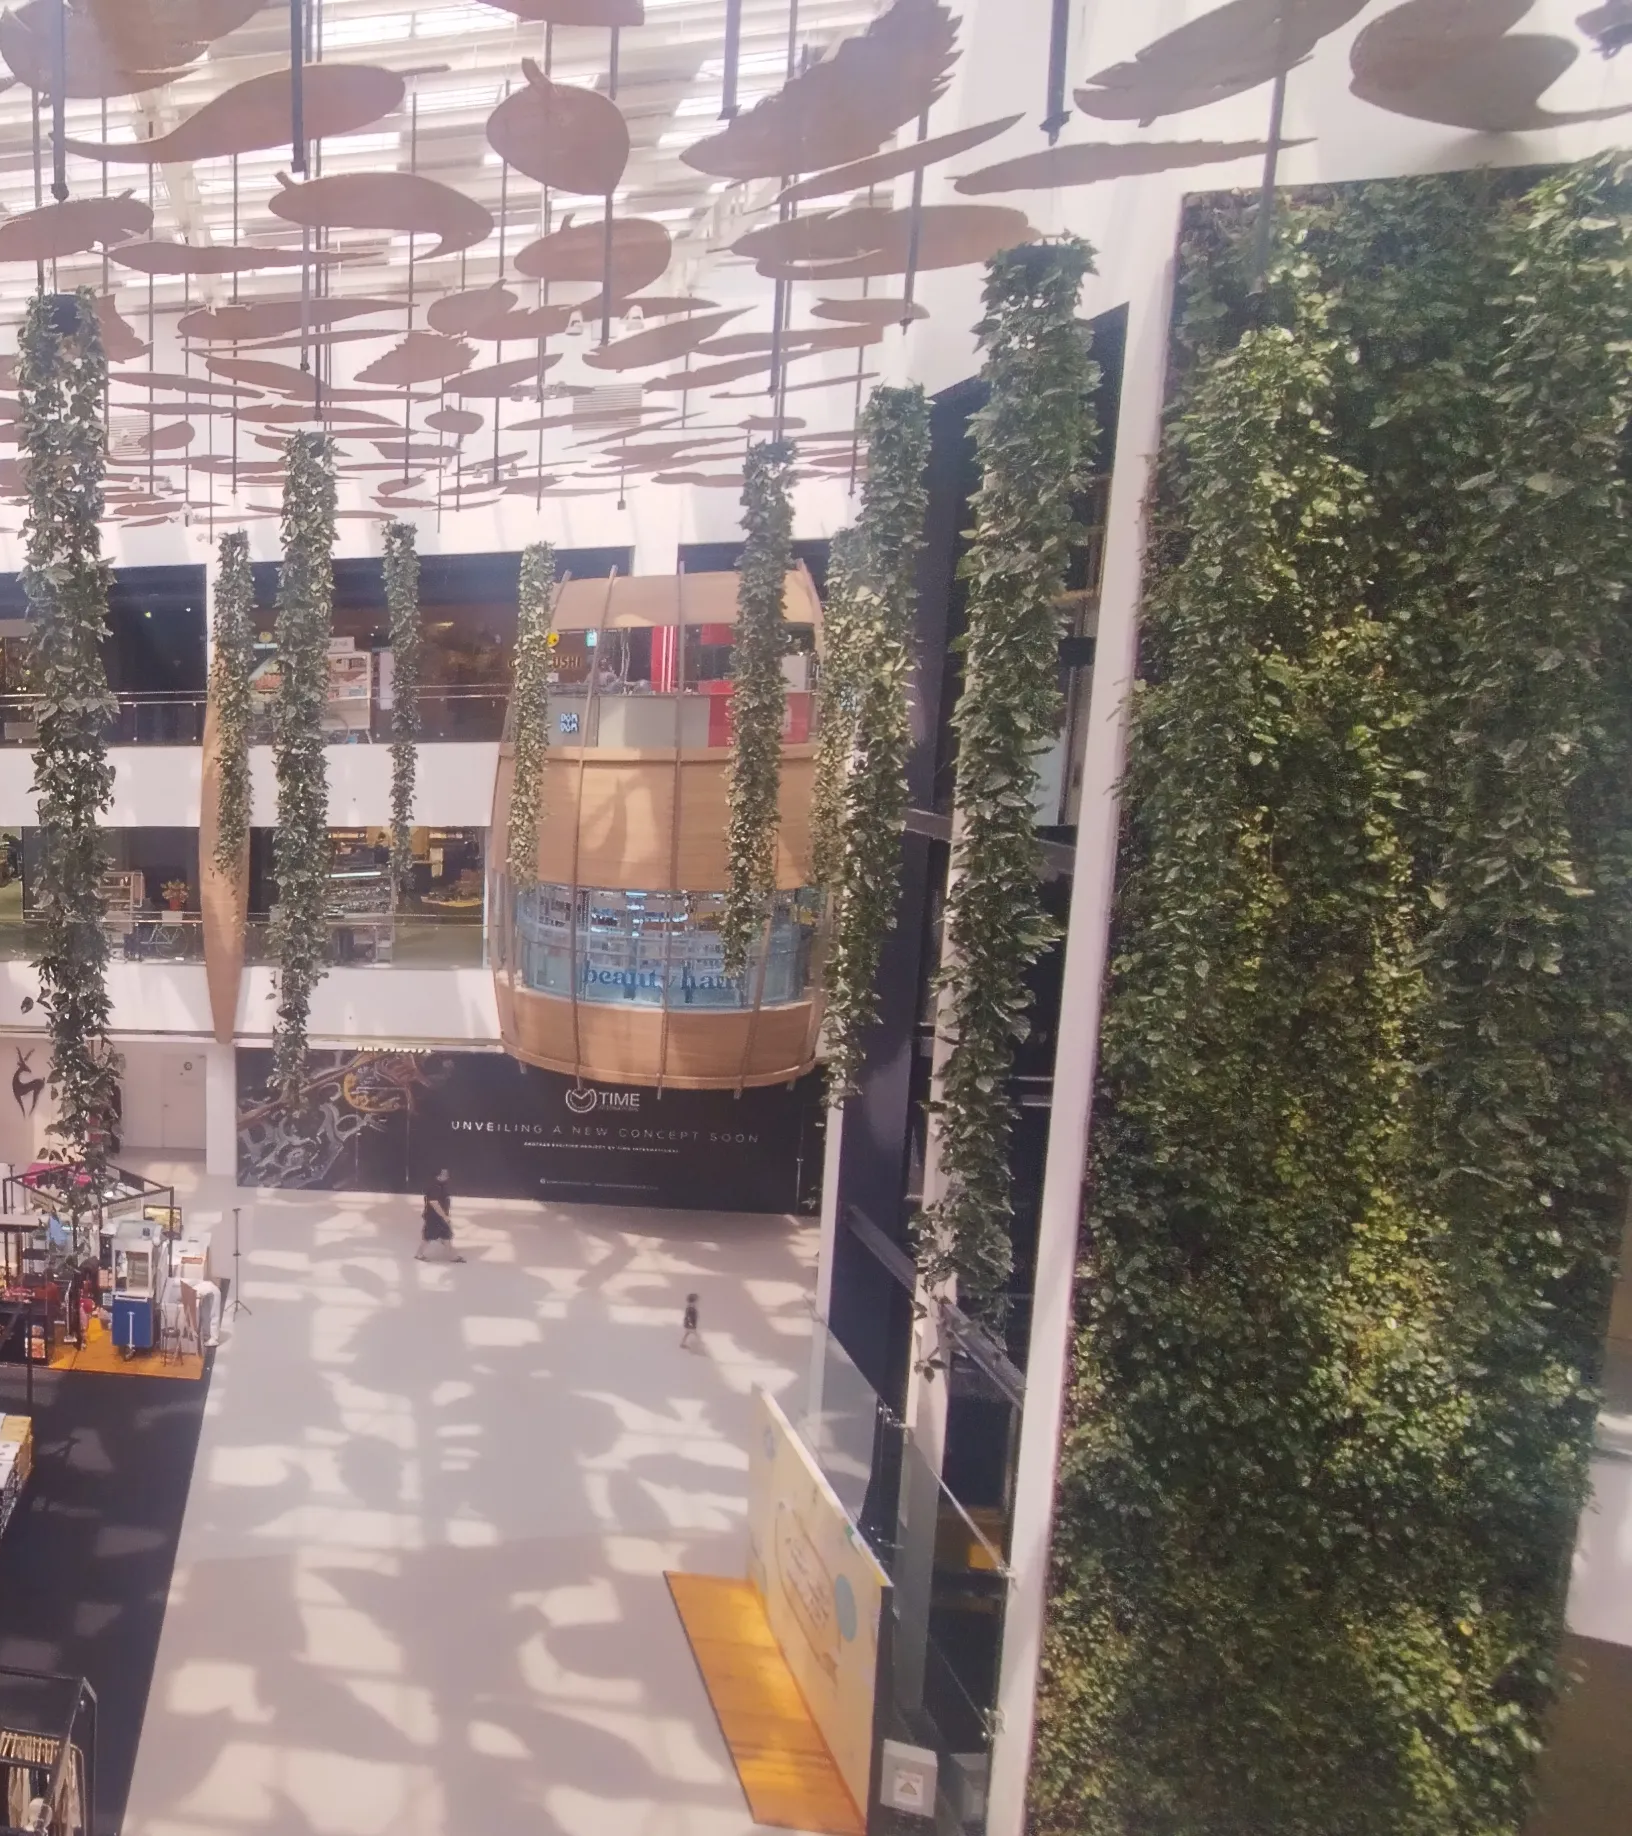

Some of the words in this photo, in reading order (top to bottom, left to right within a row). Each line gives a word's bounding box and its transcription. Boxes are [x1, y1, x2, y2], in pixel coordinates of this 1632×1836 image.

[598, 1091, 641, 1108] TIME
[451, 1120, 543, 1134] UNVEILING
[552, 1125, 562, 1135] A
[572, 1126, 608, 1137] NEW
[618, 1127, 699, 1142] CONCEPT
[709, 1132, 759, 1144] SOON
